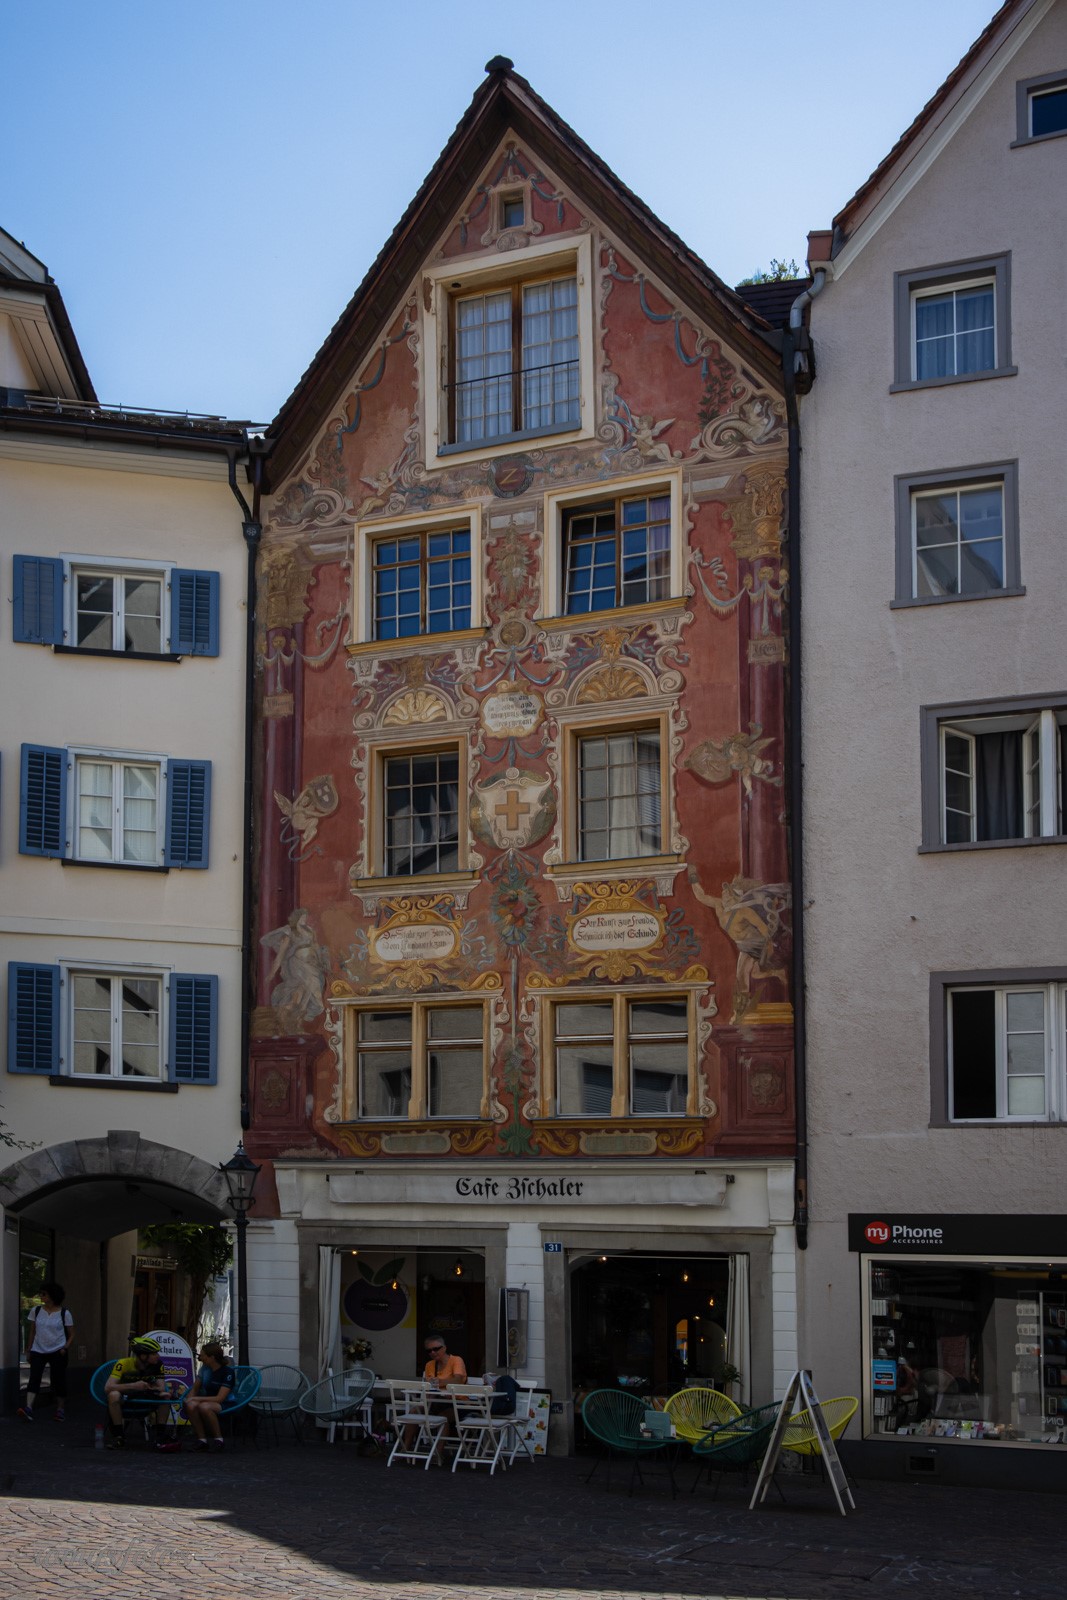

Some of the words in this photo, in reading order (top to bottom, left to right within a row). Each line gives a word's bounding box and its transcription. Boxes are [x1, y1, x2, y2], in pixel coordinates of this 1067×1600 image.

[456, 1177, 499, 1199] Cafe
[867, 1227, 888, 1240] my
[892, 1225, 943, 1238] Phone
[548, 1243, 558, 1252] 31
[156, 1336, 175, 1344] Cafe
[160, 1346, 183, 1355] chaler
